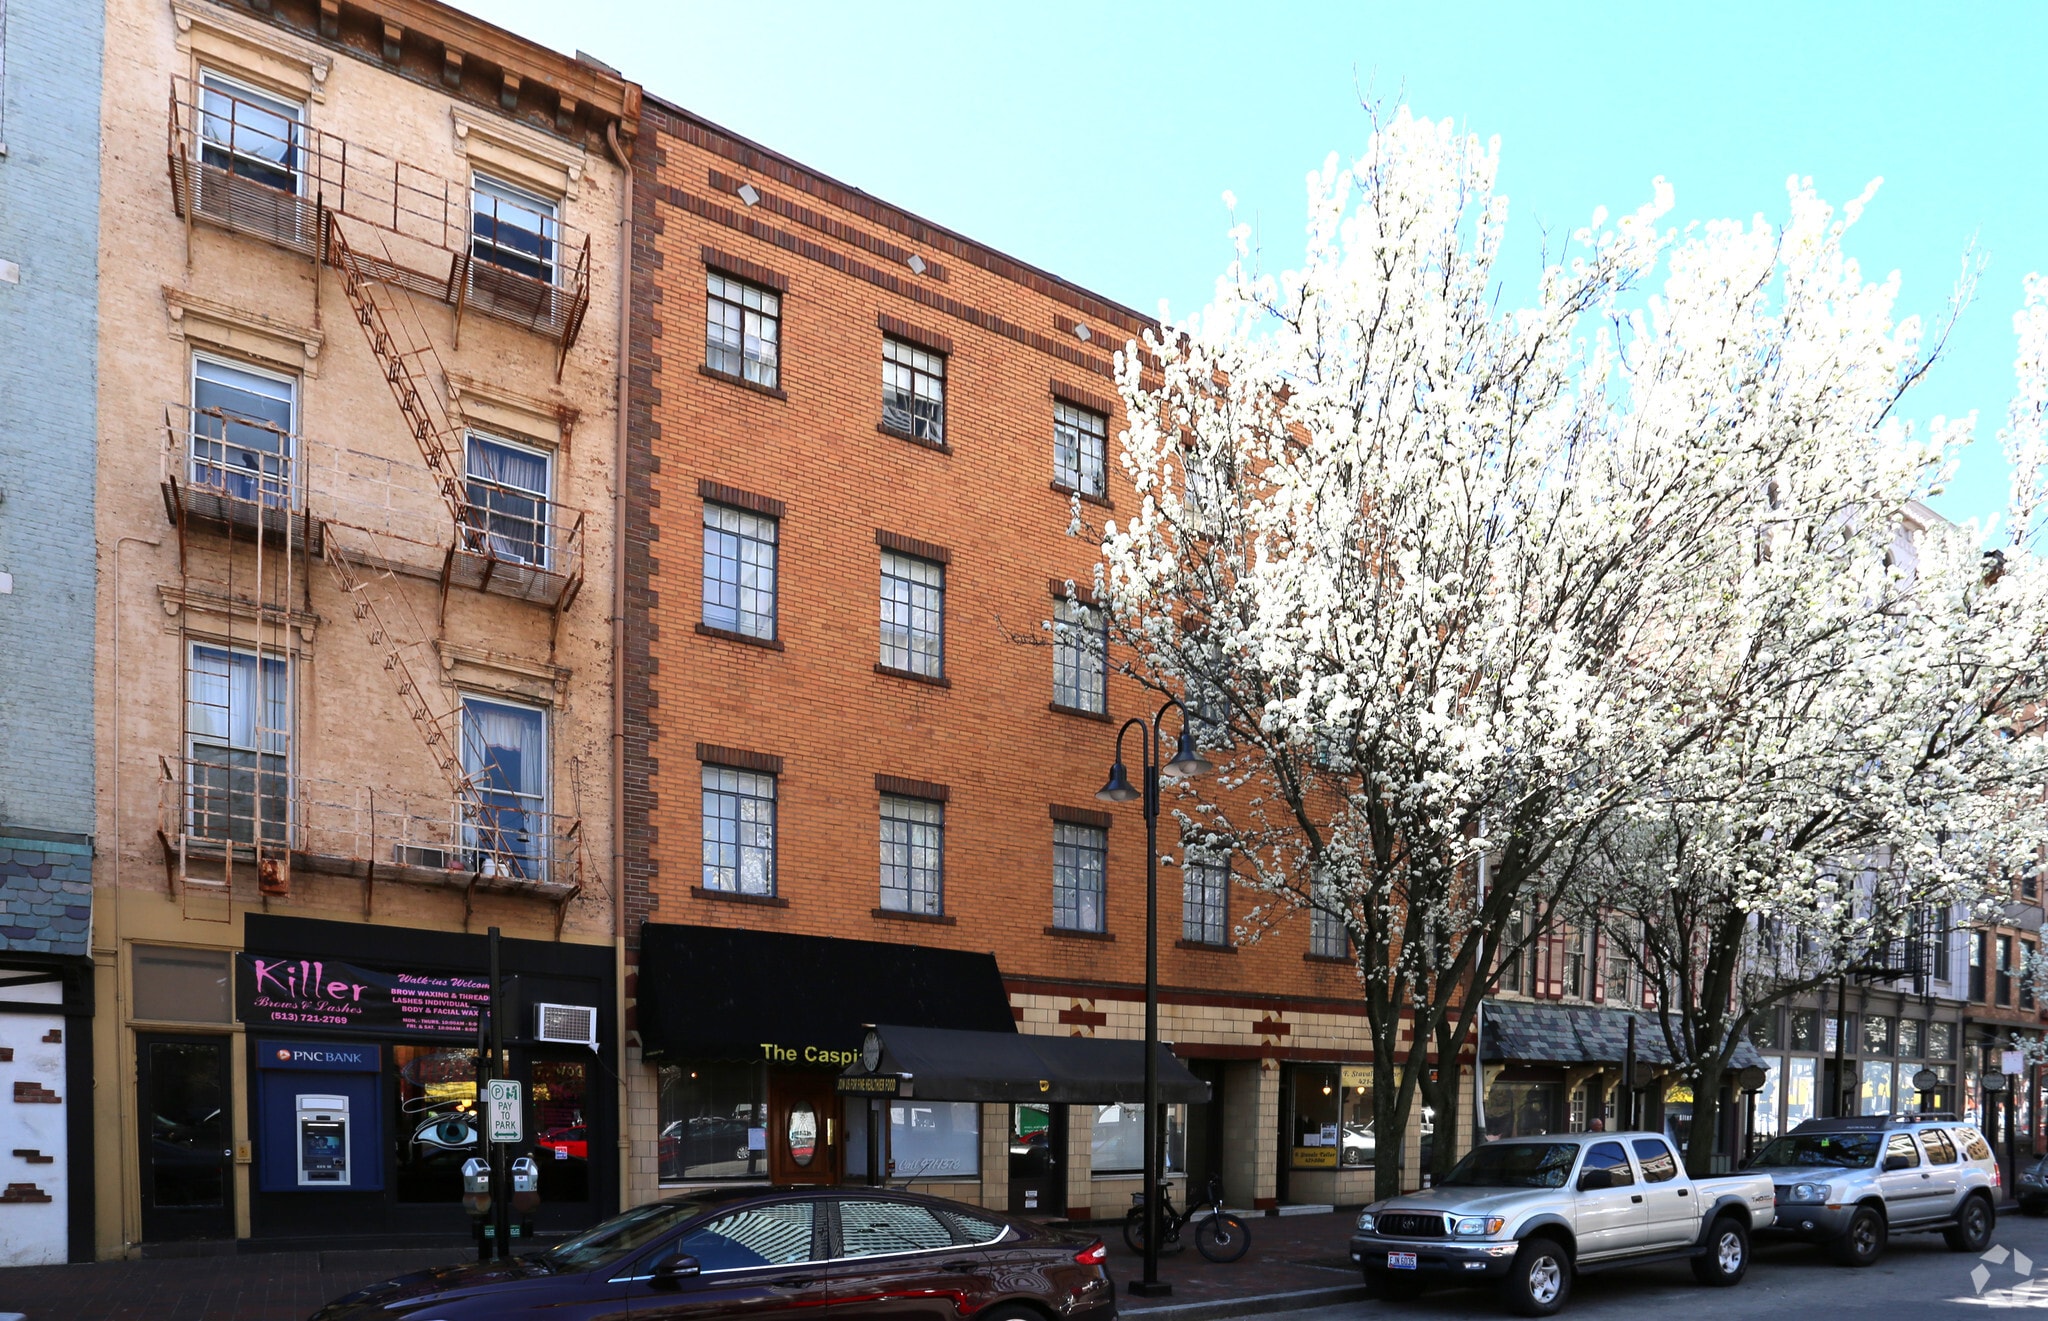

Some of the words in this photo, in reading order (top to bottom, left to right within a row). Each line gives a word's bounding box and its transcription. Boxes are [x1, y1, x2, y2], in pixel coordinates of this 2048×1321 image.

[255, 960, 368, 1001] Killer
[397, 973, 448, 986] Walk-ins
[391, 988, 415, 996] BROW
[417, 990, 449, 998] WAXING
[254, 997, 298, 1010] Brows
[315, 1000, 362, 1014] Lashes
[392, 997, 423, 1005] LASHES
[425, 1000, 470, 1008] INDIVIDUAL
[271, 1011, 298, 1022] (513)
[301, 1013, 347, 1024] 721-2769
[433, 1008, 460, 1016] FACIAL
[293, 1051, 323, 1062] PNC
[325, 1052, 362, 1063] BANK
[760, 1043, 797, 1061] The
[804, 1046, 863, 1066] Caspi
[885, 1079, 896, 1092] FOOD
[498, 1101, 513, 1111] PAY
[501, 1111, 511, 1120] TO
[495, 1121, 516, 1130] PARK
[898, 1159, 919, 1171] Call
